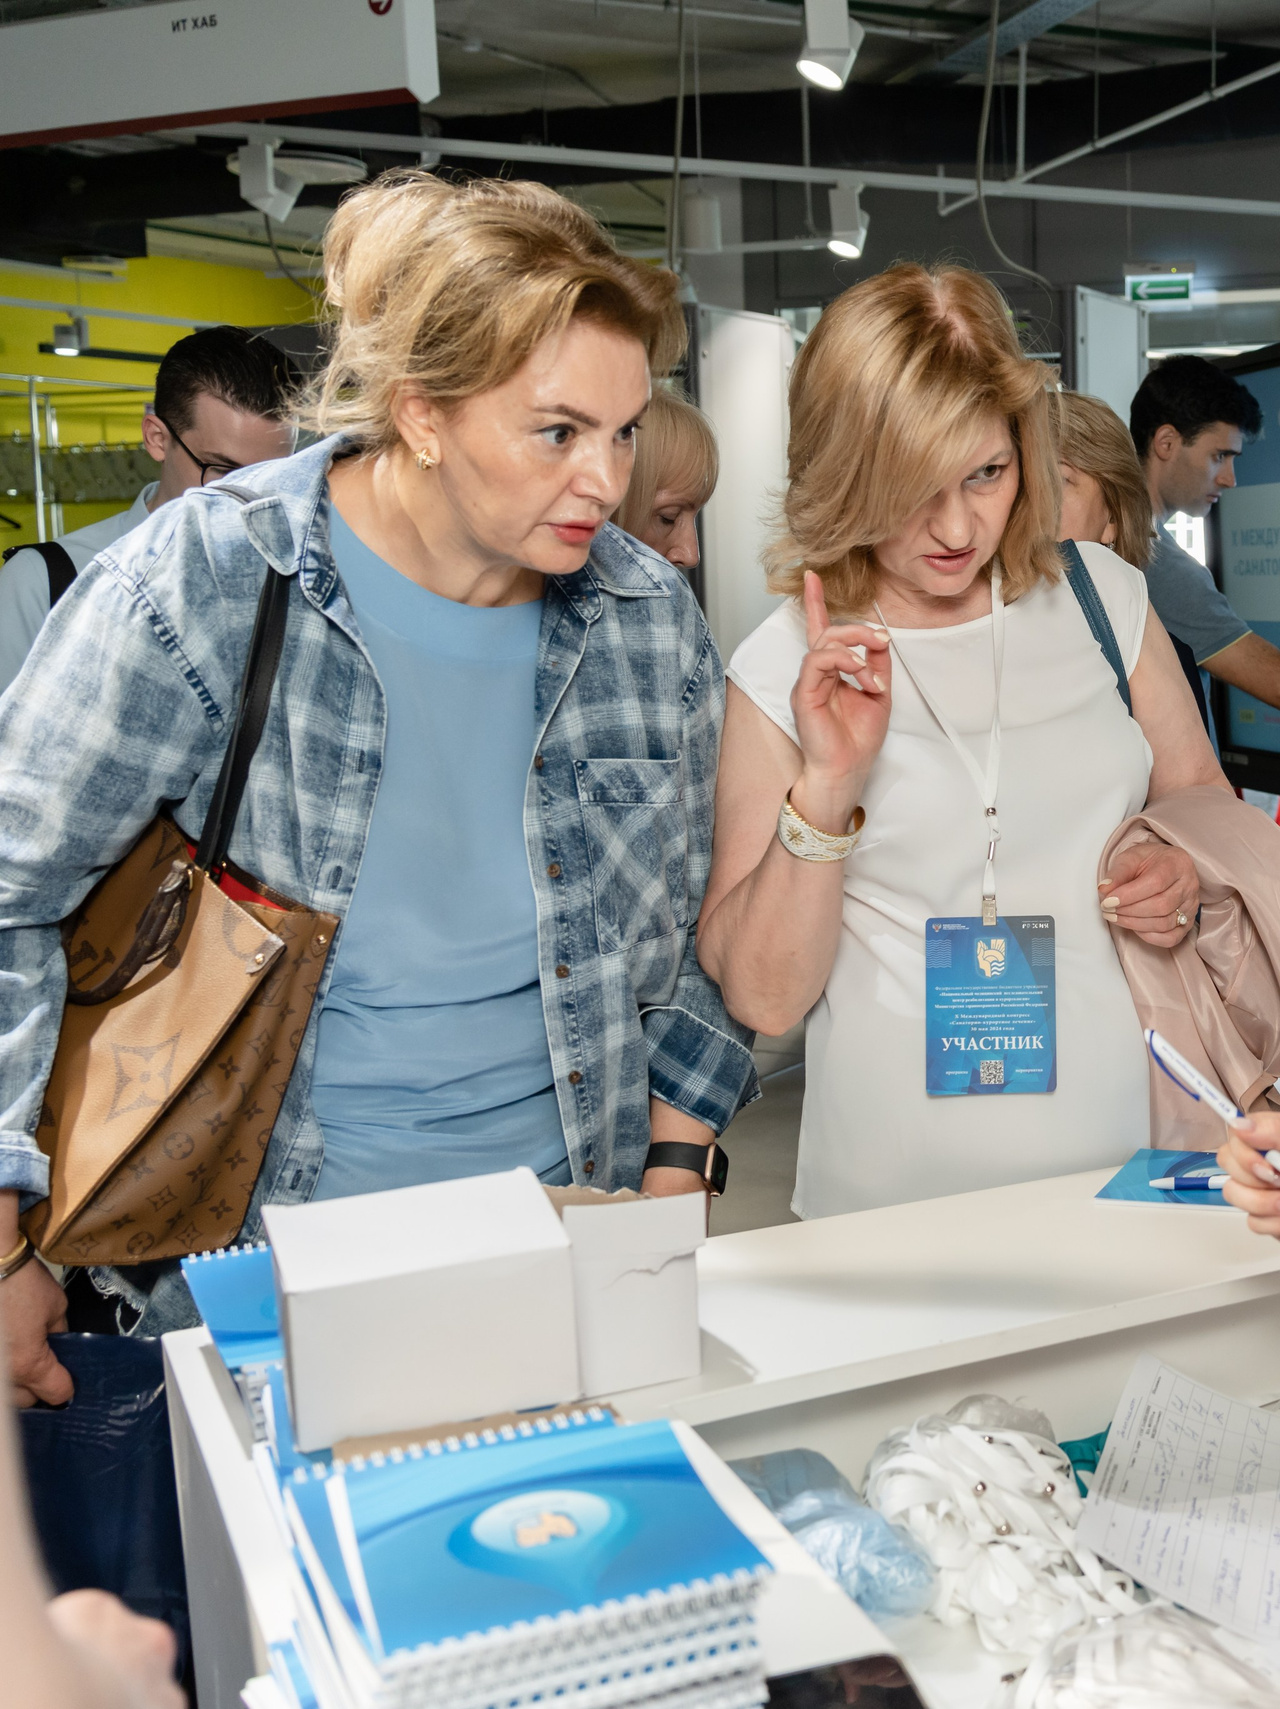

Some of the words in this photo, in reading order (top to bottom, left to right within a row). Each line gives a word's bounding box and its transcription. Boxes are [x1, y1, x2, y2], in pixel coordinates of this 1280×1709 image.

[171, 18, 187, 32] ИТ
[191, 14, 217, 29] ХАБ
[940, 1035, 1044, 1052] УЧАСТНИК
